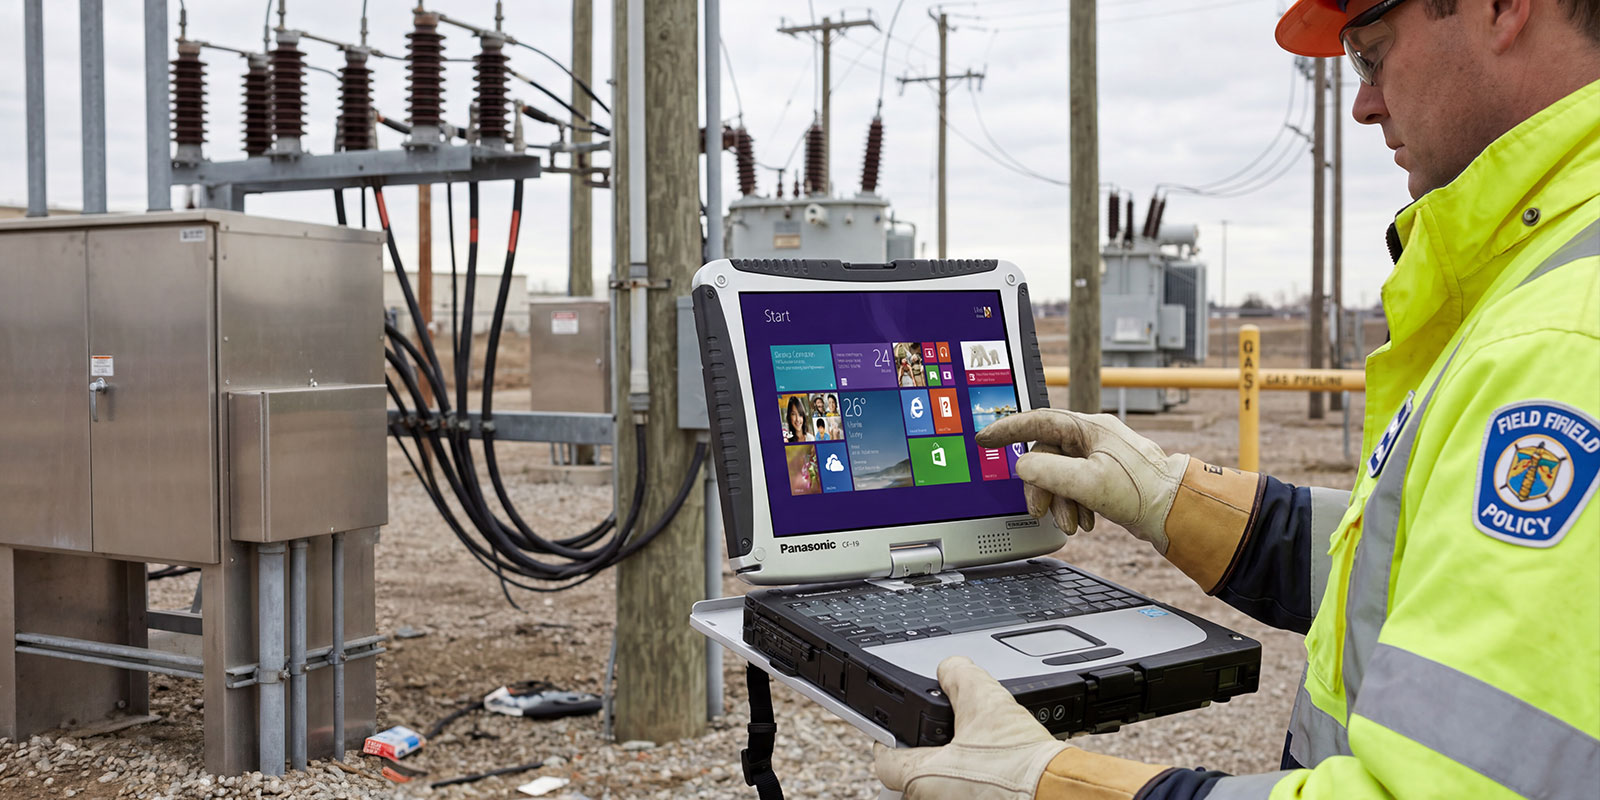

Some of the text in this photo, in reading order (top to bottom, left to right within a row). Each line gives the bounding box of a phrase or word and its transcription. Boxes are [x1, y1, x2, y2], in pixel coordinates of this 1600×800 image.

[764, 309, 791, 323] Start
[873, 348, 891, 368] 24
[1243, 340, 1254, 389] GAS
[1265, 375, 1288, 386] GAS
[1497, 410, 1600, 453] FIELD FIRIELD
[1481, 503, 1552, 536] POLICY
[780, 539, 837, 554] Panasonic
